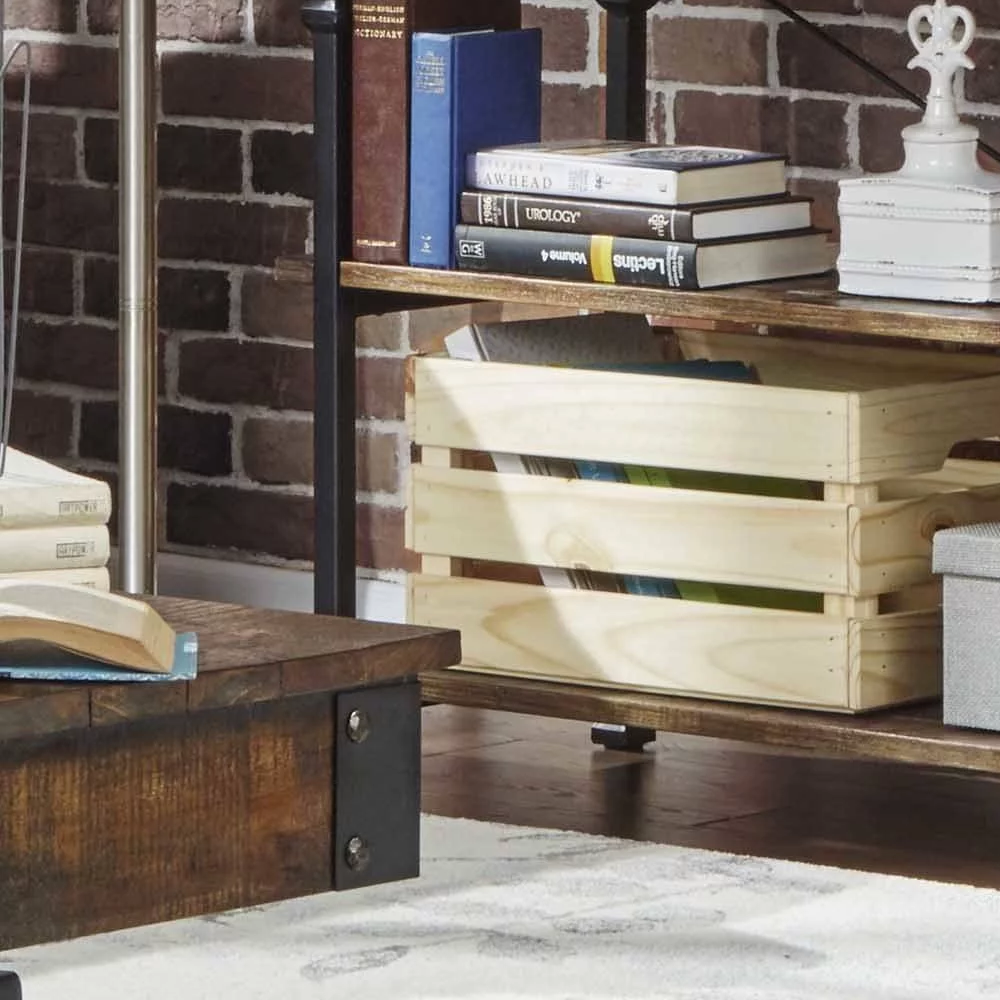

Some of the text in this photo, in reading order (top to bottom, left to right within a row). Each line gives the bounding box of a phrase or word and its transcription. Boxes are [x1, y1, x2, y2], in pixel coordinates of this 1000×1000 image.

[541, 249, 588, 265] Volume 4
[613, 253, 666, 276] Lectins
